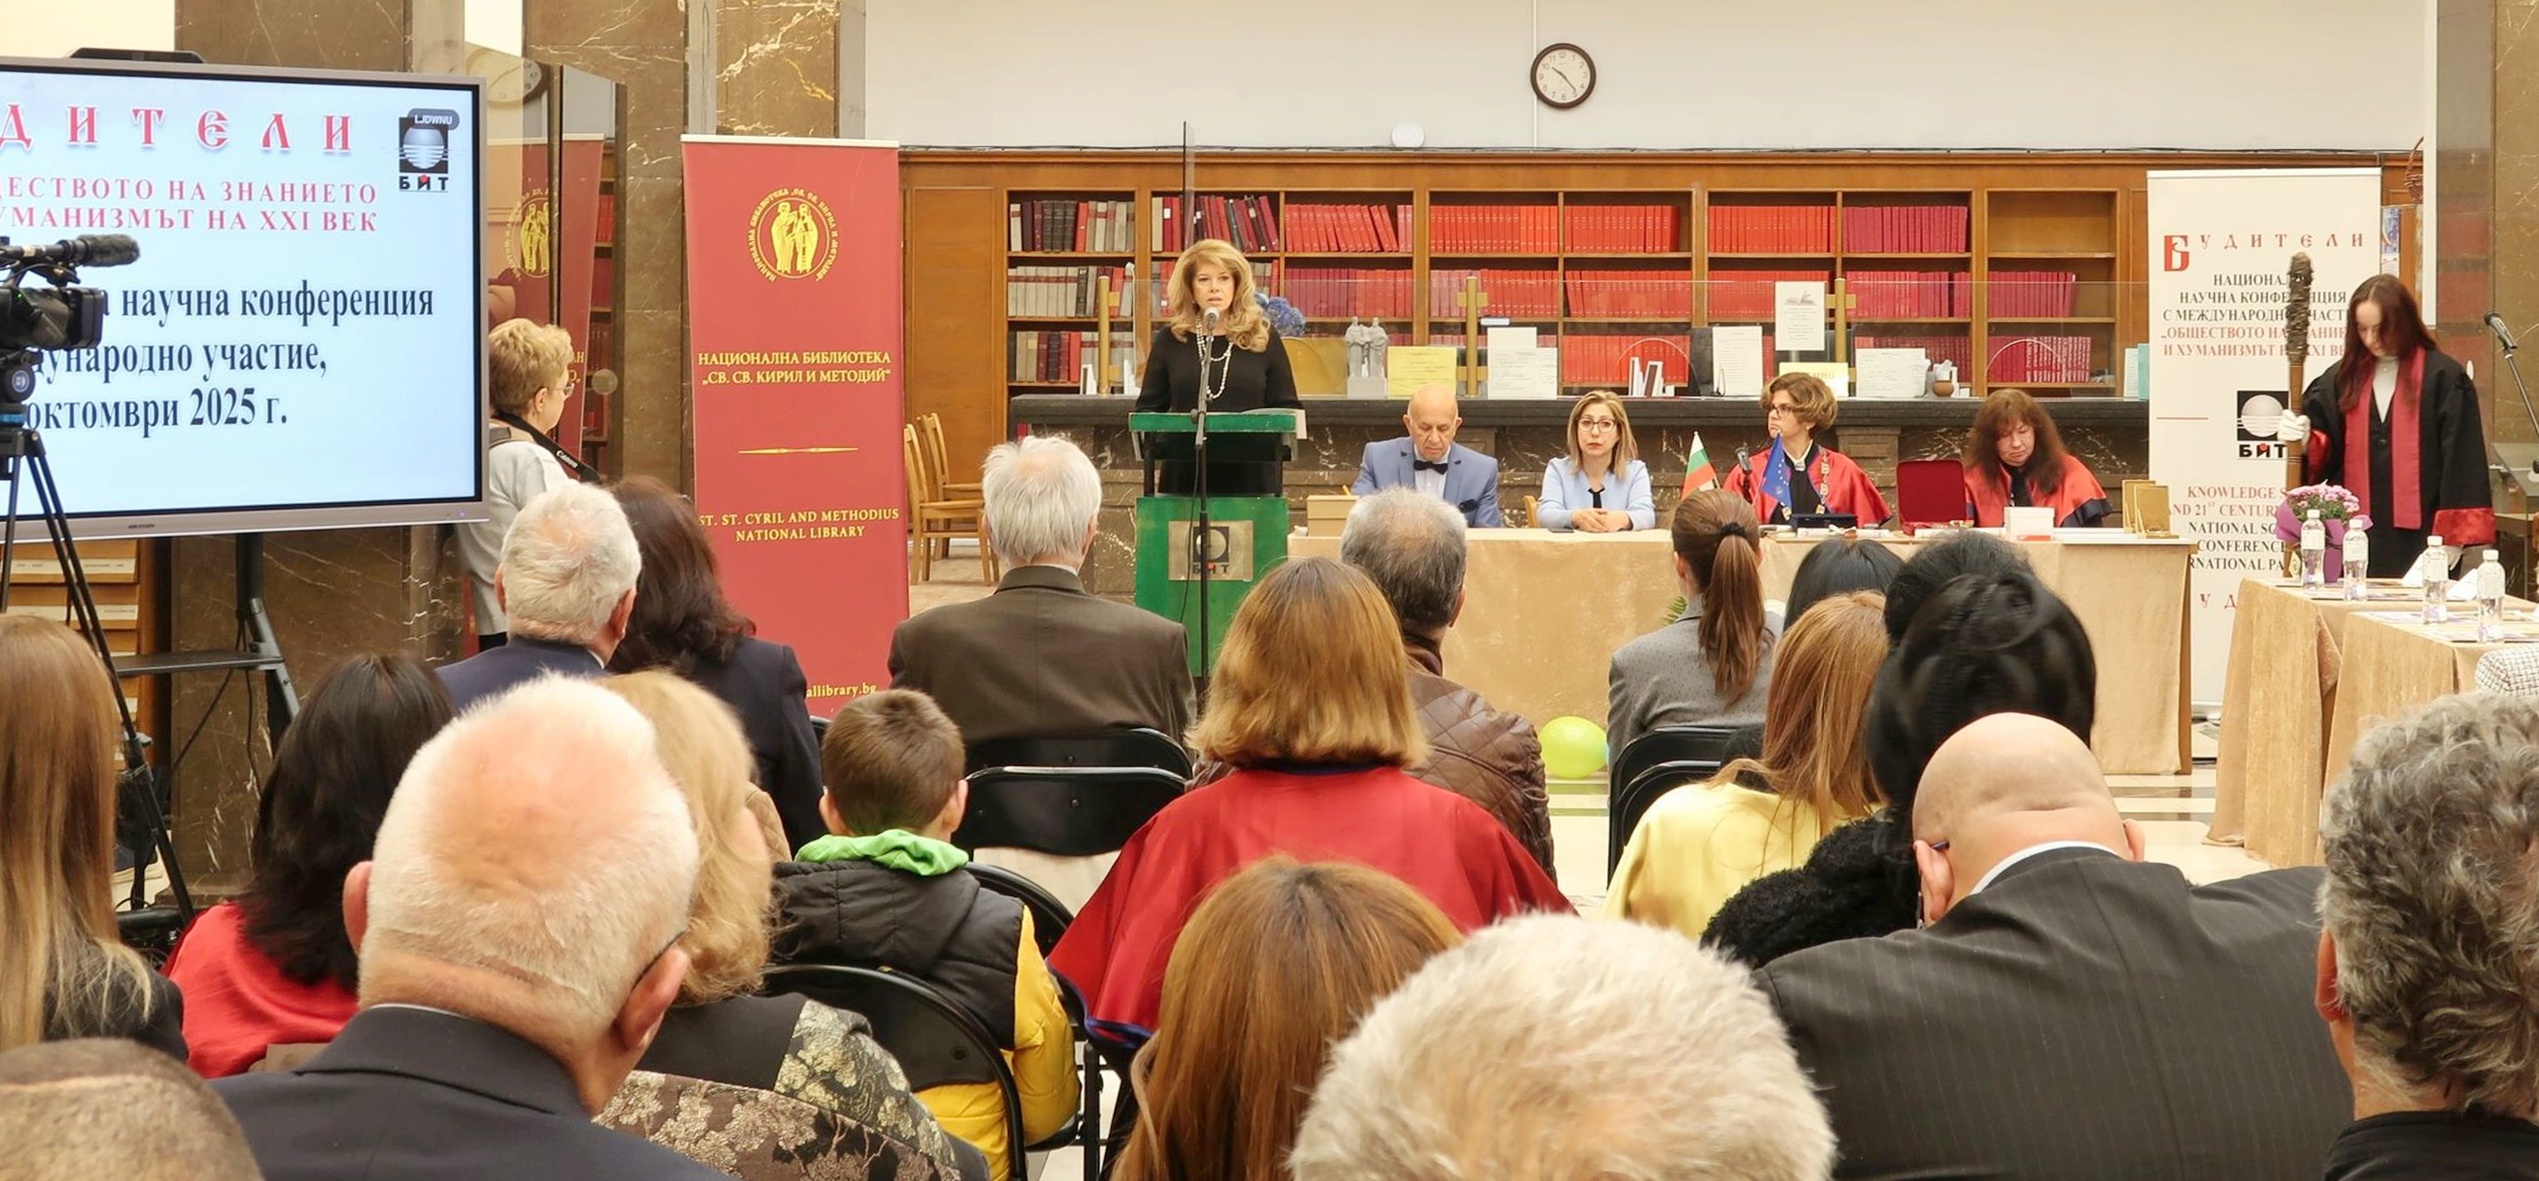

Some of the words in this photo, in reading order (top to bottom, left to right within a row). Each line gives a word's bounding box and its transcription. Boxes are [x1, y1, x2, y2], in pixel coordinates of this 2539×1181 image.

[0, 177, 153, 200] ЕСТВОТО
[168, 180, 206, 201] НА
[221, 181, 376, 204] ЗНАНИЕТО
[399, 175, 448, 191] БИТ
[207, 210, 247, 230] НА
[322, 211, 377, 231] ВЕК
[2213, 274, 2290, 287] НАЦИОНА
[122, 289, 229, 327] научна
[240, 279, 434, 327] конференция
[2180, 291, 2236, 304] НАУЧНА
[2240, 291, 2346, 305] КОНФЕНЦИЯ
[2163, 309, 2173, 322] С
[2175, 309, 2288, 322] МЕЖДУНАРОДН
[2308, 309, 2349, 322] ЧАСТ
[2163, 344, 2173, 356] И
[2177, 344, 2275, 357] ХУМАНИЗМЪТ
[202, 343, 327, 382] участие,
[698, 352, 800, 367] НАЦИОНАЛНА
[802, 351, 891, 365] БИБЛИОТЕКА
[702, 371, 730, 386] „СВ.
[732, 371, 754, 385] СВ.
[756, 370, 803, 384] КИРИЛ
[806, 370, 817, 383] И
[819, 367, 892, 384] МЕТОДИЙ“
[26, 399, 179, 439] октомври
[190, 387, 256, 426] 2025
[266, 397, 287, 424] г.
[2239, 443, 2287, 458] БИТ
[556, 450, 578, 468] Canon
[2188, 486, 2276, 499] KNOWLEDGE
[699, 514, 718, 527] ST.
[721, 513, 742, 526] ST.
[745, 511, 785, 525] CYRIL
[788, 510, 817, 523] AND
[821, 507, 900, 523] METHODIUS
[2169, 504, 2192, 516] ND
[735, 527, 806, 542] NATIONAL
[810, 525, 865, 540] LIBRARY
[2188, 521, 2258, 534] NATIONAL
[2190, 558, 2265, 571] RNATIONAL
[806, 682, 877, 698] allibrary.bg
